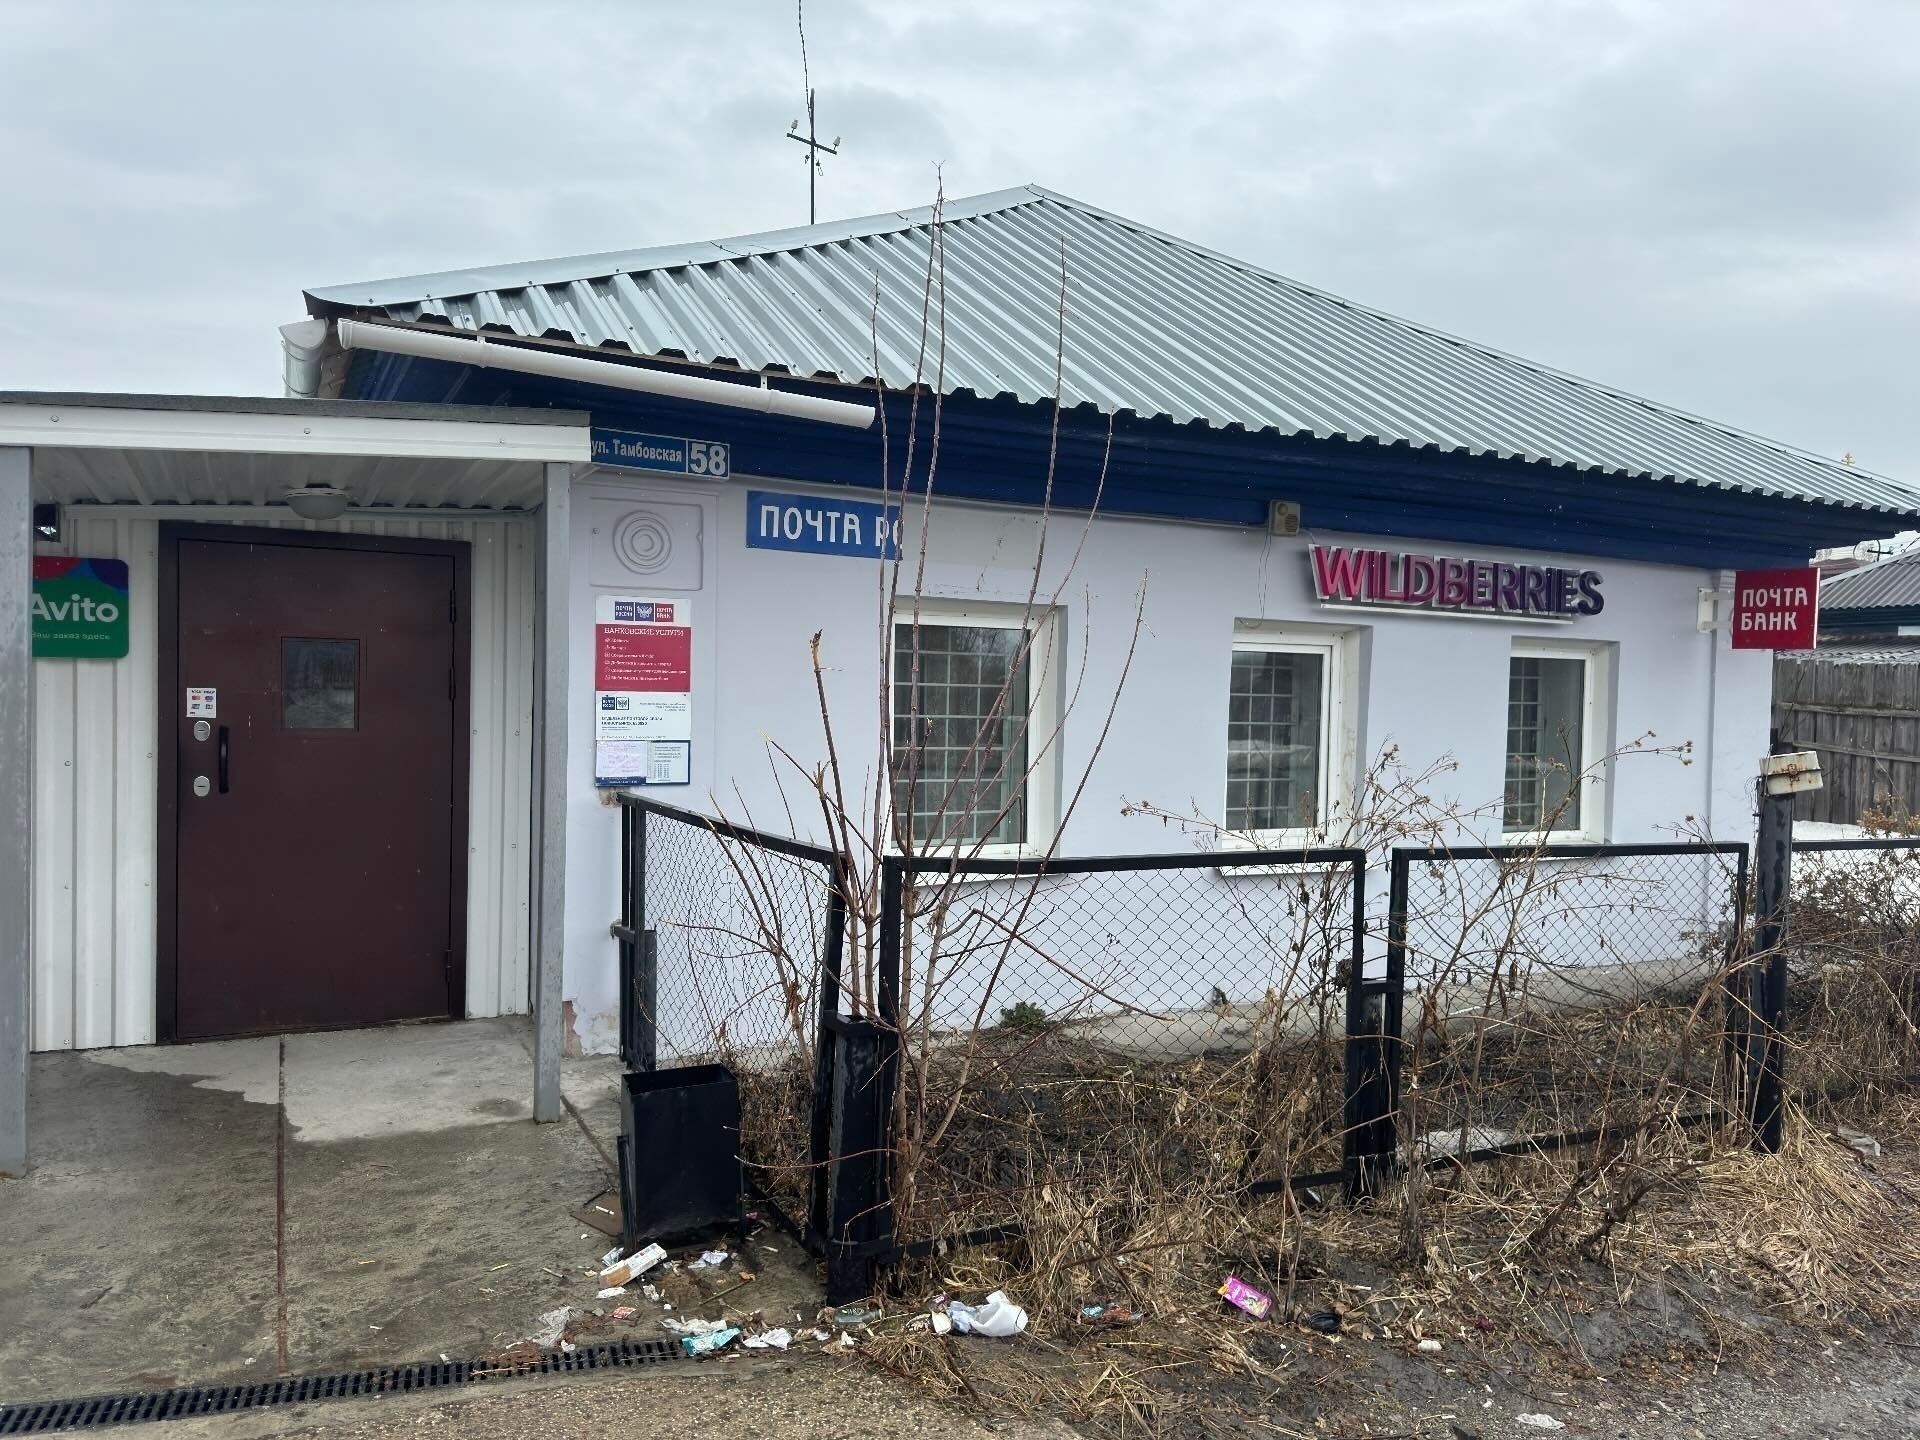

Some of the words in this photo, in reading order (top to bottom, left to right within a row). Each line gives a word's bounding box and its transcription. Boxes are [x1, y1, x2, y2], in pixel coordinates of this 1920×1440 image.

[591, 440, 609, 456] ул.
[612, 439, 682, 462] Тамбовская
[689, 443, 726, 475] 58
[760, 505, 861, 545] ПОЧТА
[1309, 544, 1604, 616] WILDBERRIES
[32, 593, 119, 623] Avito
[1742, 587, 1808, 608] ПОЧТА
[604, 627, 655, 636] БАНКОВСКИЕ
[655, 629, 684, 637] УСЛУГИ
[1741, 612, 1797, 631] БАНК
